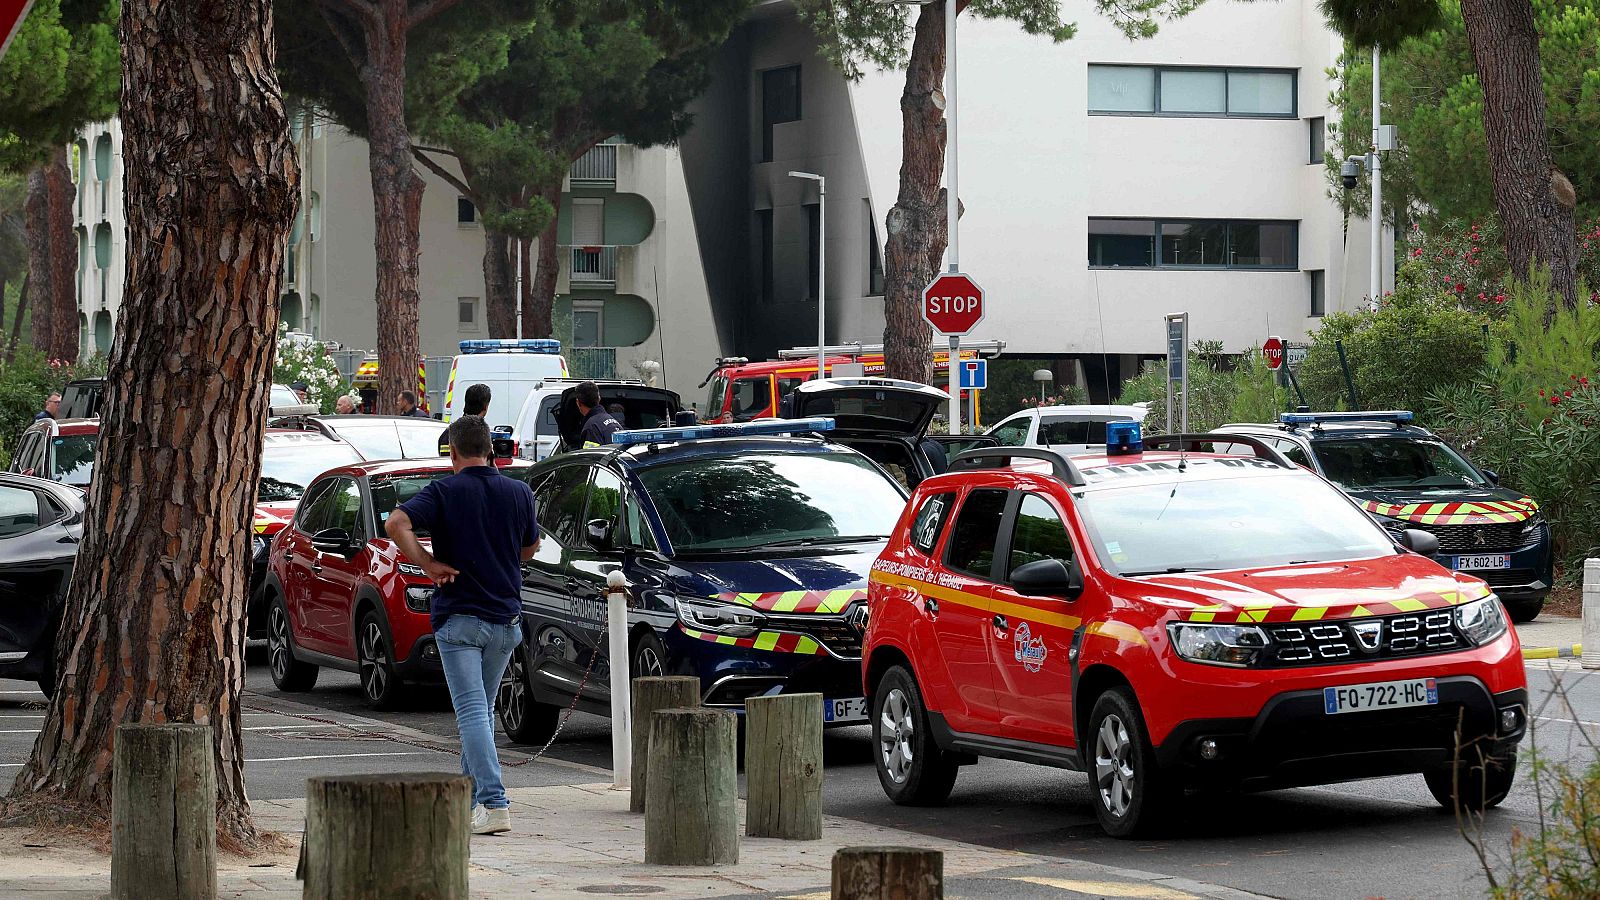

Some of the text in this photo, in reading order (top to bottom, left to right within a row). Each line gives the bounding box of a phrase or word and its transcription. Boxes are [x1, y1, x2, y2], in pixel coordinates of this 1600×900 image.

[929, 296, 978, 314] STOP
[1264, 348, 1282, 359] STOP
[872, 558, 928, 581] SAPEURS-POMPIERS
[925, 570, 933, 582] de
[1460, 557, 1504, 569] FX-602-LB
[1337, 682, 1426, 710] FQ-722-HC
[1428, 691, 1437, 700] 34
[835, 699, 868, 718] GF-2
